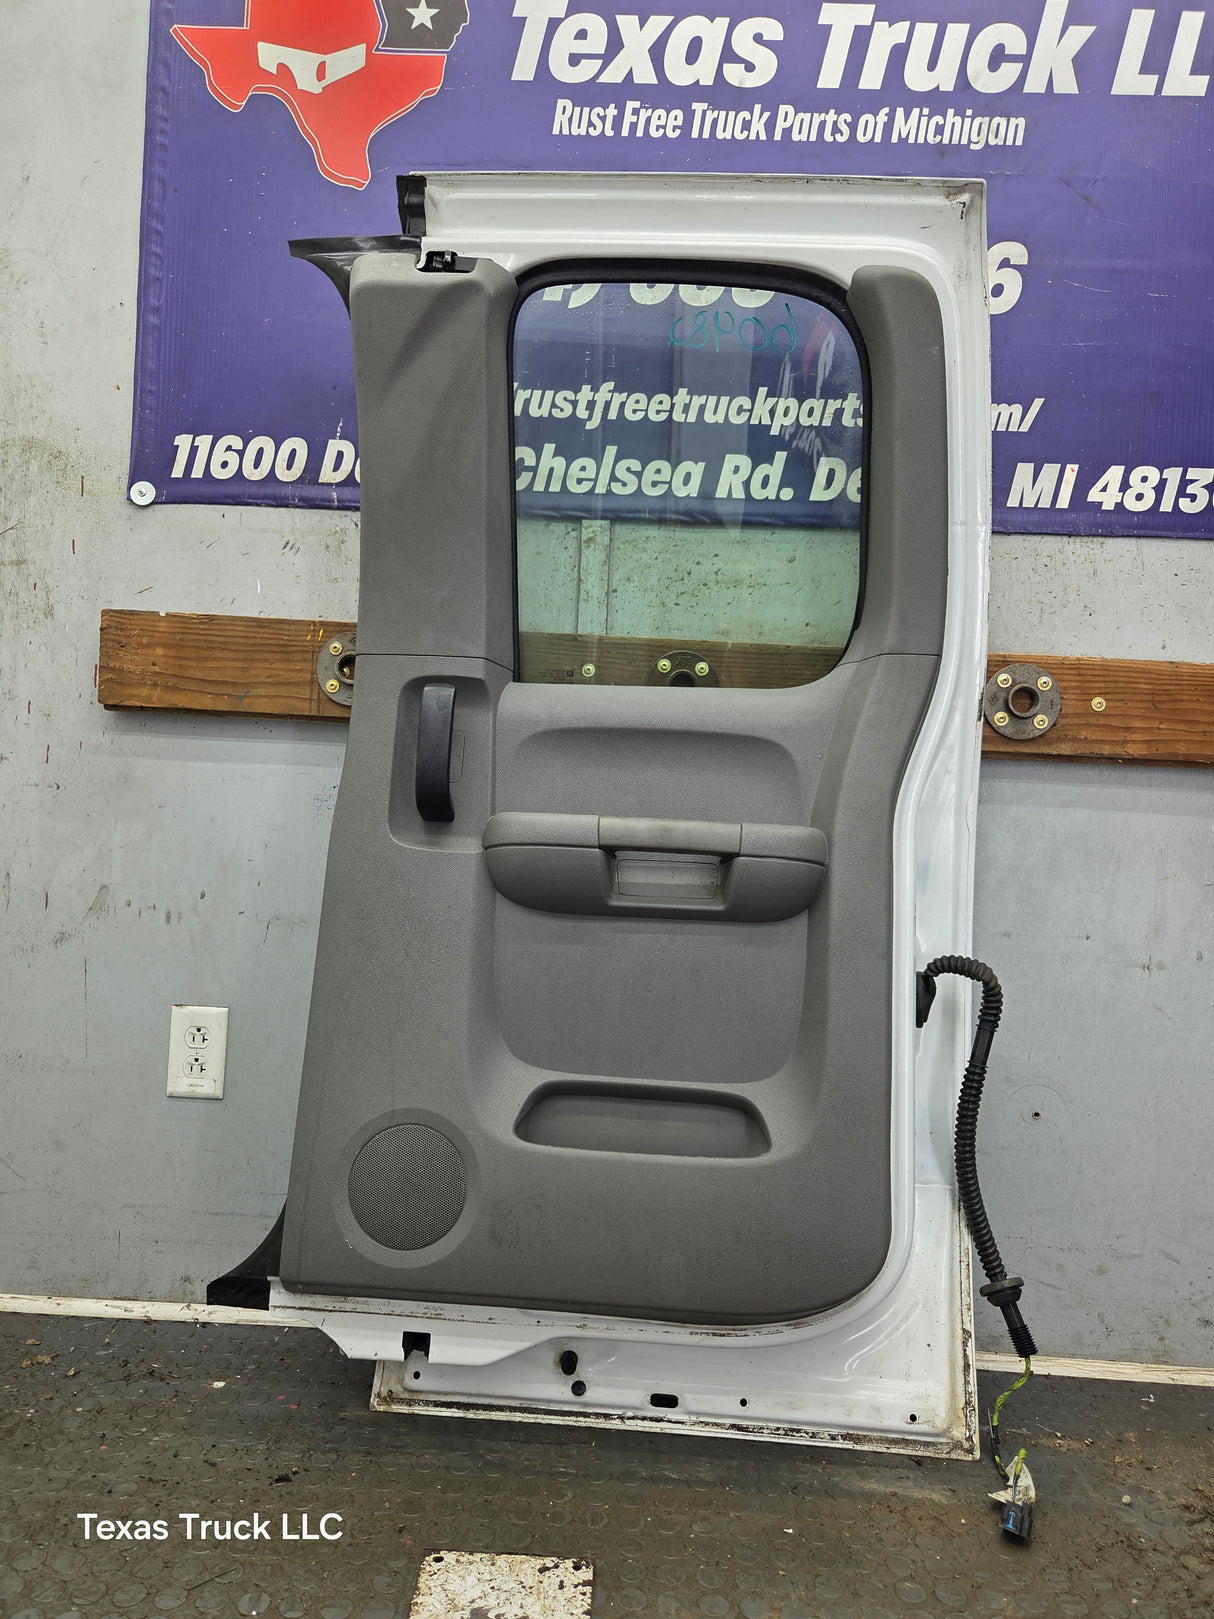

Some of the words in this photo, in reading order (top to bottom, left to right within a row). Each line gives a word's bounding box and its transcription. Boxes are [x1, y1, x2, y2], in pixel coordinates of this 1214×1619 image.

[511, 0, 784, 88] Texas
[816, 0, 1097, 94] Truck
[1110, 8, 1211, 97] LL
[552, 98, 617, 137] Rust
[621, 100, 684, 138] Free
[690, 102, 771, 141] Truck
[774, 104, 852, 143] Parts
[856, 107, 890, 144] of
[891, 107, 1026, 150] Michigan
[514, 382, 864, 435] rustfreetruckparts
[170, 434, 308, 482] 11600
[318, 439, 360, 483] D
[515, 443, 705, 497] Chelsea
[715, 451, 794, 501] Rd.
[1006, 463, 1079, 509] MI
[1087, 465, 1214, 513] 4813
